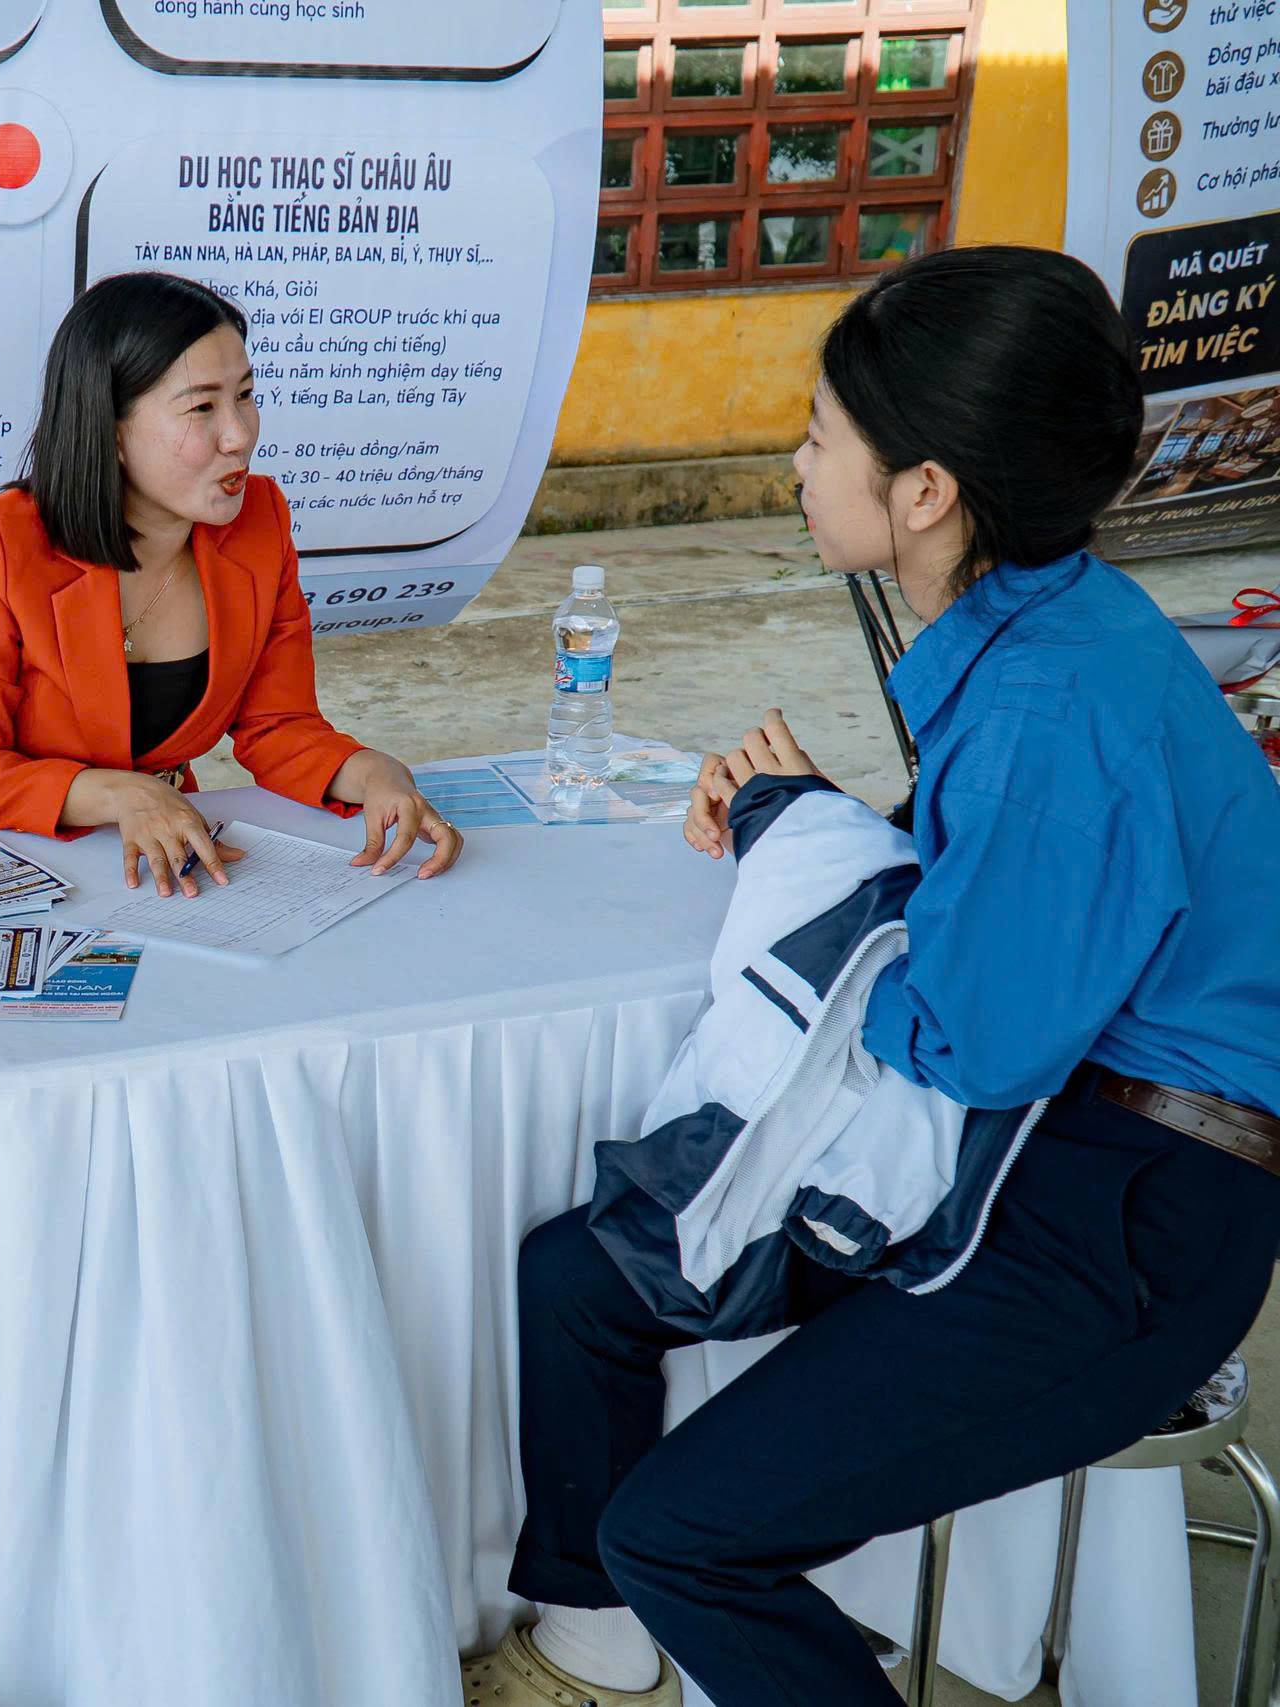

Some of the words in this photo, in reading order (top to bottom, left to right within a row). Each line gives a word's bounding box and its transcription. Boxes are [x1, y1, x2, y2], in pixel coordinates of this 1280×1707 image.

[296, 0, 327, 22] học
[332, 1, 365, 19] sinh
[178, 155, 209, 189] DU
[217, 156, 261, 198] HỌC
[270, 156, 325, 197] THẠC
[360, 151, 416, 191] CHÂU
[423, 151, 451, 192] ÂU
[1197, 172, 1220, 192] Cơ
[1222, 165, 1248, 190] hội
[1249, 160, 1280, 188] phá
[386, 205, 418, 241] ĐỊA
[163, 245, 192, 261] BAN
[196, 245, 229, 265] NHA,
[257, 245, 287, 265] LAN,
[335, 246, 352, 262] BA
[356, 246, 385, 265] LAN,
[412, 243, 422, 265] Ý,
[428, 246, 463, 266] THỤY
[1169, 250, 1203, 280] MÃ
[1208, 241, 1270, 274] QUÉT
[244, 279, 278, 300] Khá,
[1146, 288, 1230, 328] ĐĂNG
[1235, 273, 1276, 313] KÝ
[280, 307, 304, 325] với
[308, 308, 323, 325] EI
[329, 308, 392, 325] GROUP
[397, 307, 439, 325] trước
[443, 308, 467, 325] khi
[471, 313, 500, 329] qua
[1140, 337, 1189, 372] TÌM
[1196, 324, 1260, 363] VIỆC
[257, 443, 278, 460] 60
[294, 443, 315, 458] 80
[320, 442, 355, 461] triệu
[326, 586, 388, 605] 690
[395, 581, 455, 599] 239
[312, 612, 424, 633] igroup.io
